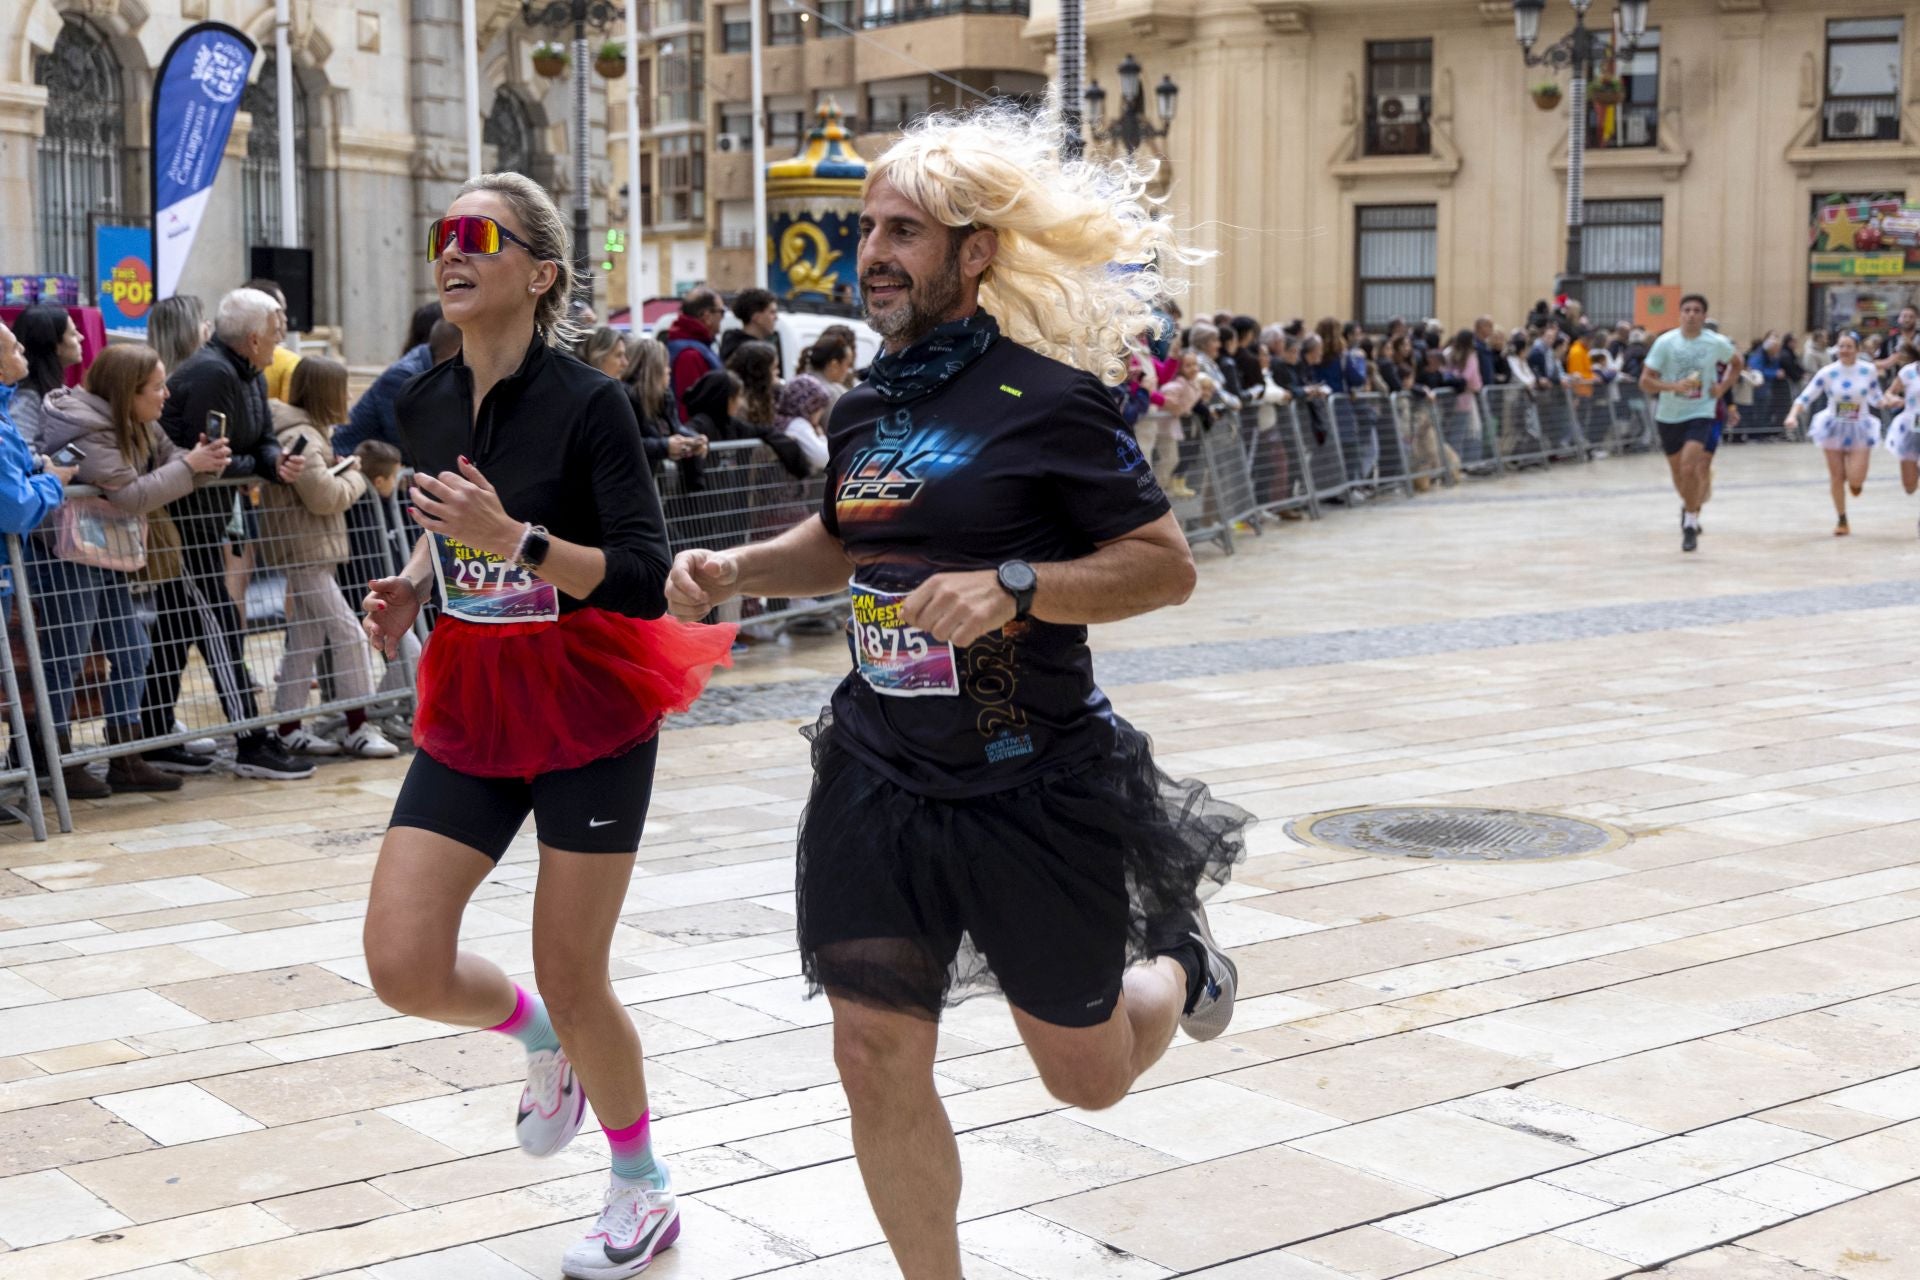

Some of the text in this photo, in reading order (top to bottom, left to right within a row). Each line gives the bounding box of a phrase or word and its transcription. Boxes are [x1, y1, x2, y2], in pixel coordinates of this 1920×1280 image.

[841, 483, 906, 500] CPC
[456, 547, 492, 560] SILV
[454, 557, 532, 591] 2973
[852, 594, 875, 609] SAN
[855, 602, 905, 624] SILVEST
